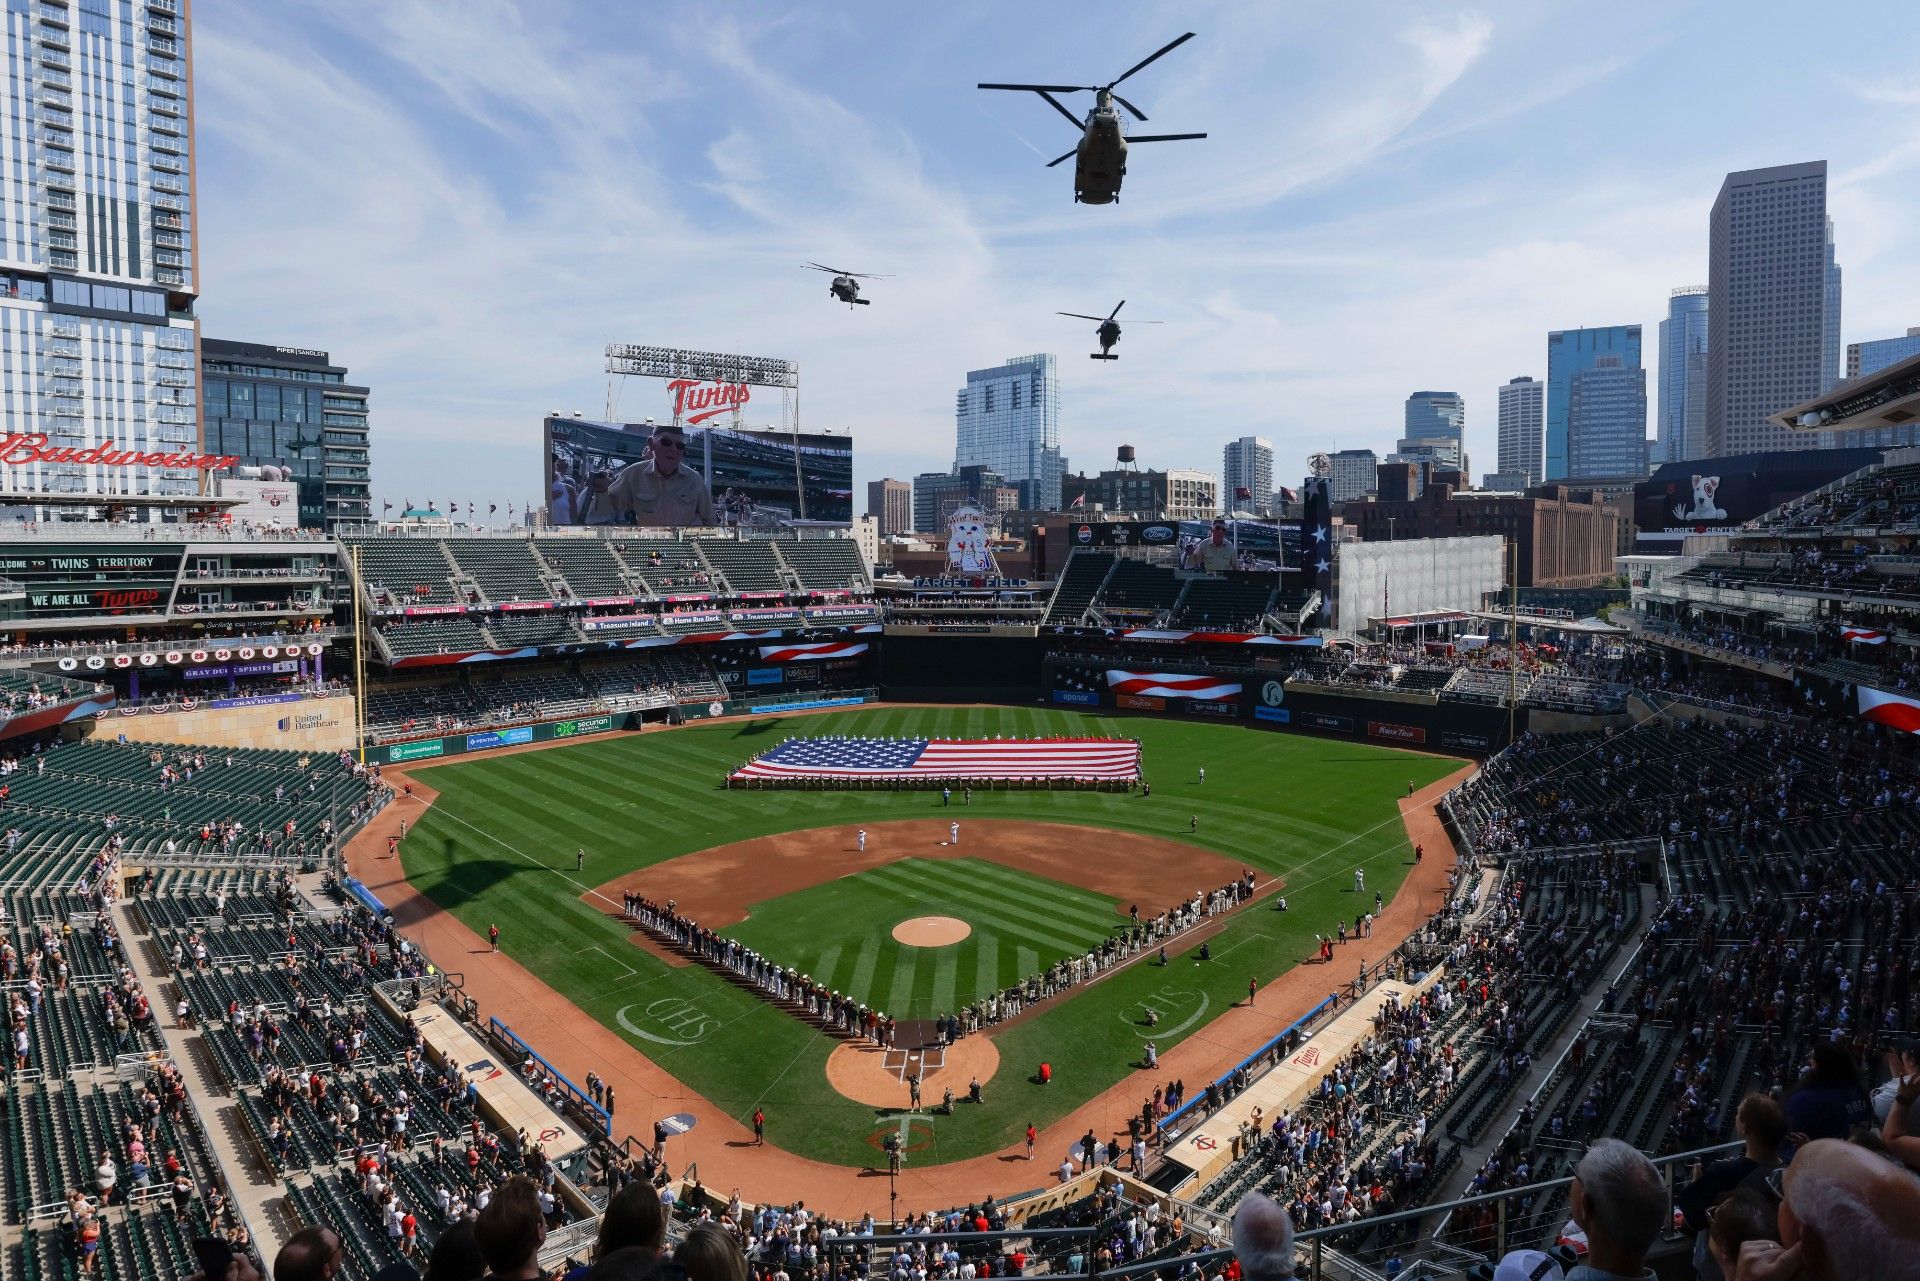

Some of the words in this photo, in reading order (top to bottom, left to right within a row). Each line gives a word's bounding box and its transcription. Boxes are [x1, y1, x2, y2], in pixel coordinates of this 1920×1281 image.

[297, 349, 326, 358] SANDLER
[668, 376, 751, 416] Twins
[0, 432, 241, 470] Budweiser
[1149, 530, 1167, 538] Ford
[51, 558, 89, 569] TWINS
[96, 557, 154, 567] TERRITORY
[915, 578, 971, 588] TARGET
[986, 578, 1029, 588] FIELD
[32, 595, 48, 606] WE
[52, 594, 70, 606] ARE
[73, 594, 90, 605] ALL
[95, 589, 159, 608] Twins
[1545, 608, 1574, 618] FIELD
[600, 621, 628, 629] Treasure
[145, 656, 151, 664] 7
[217, 651, 228, 659] 34
[63, 660, 72, 668] W
[90, 659, 100, 667] 42
[185, 668, 210, 678] GRAY
[238, 664, 272, 674] SPIRITS
[732, 672, 739, 682] 9
[232, 698, 255, 706] GRAY
[1063, 692, 1089, 702] uponor
[294, 713, 322, 723] United
[577, 718, 608, 728] securian
[1324, 718, 1339, 726] bank
[295, 719, 339, 730] Healthcare
[476, 736, 499, 744] PENTAIR
[403, 744, 441, 755] JamesHardie
[646, 998, 721, 1039] CHS
[1292, 1046, 1319, 1068] Twins
